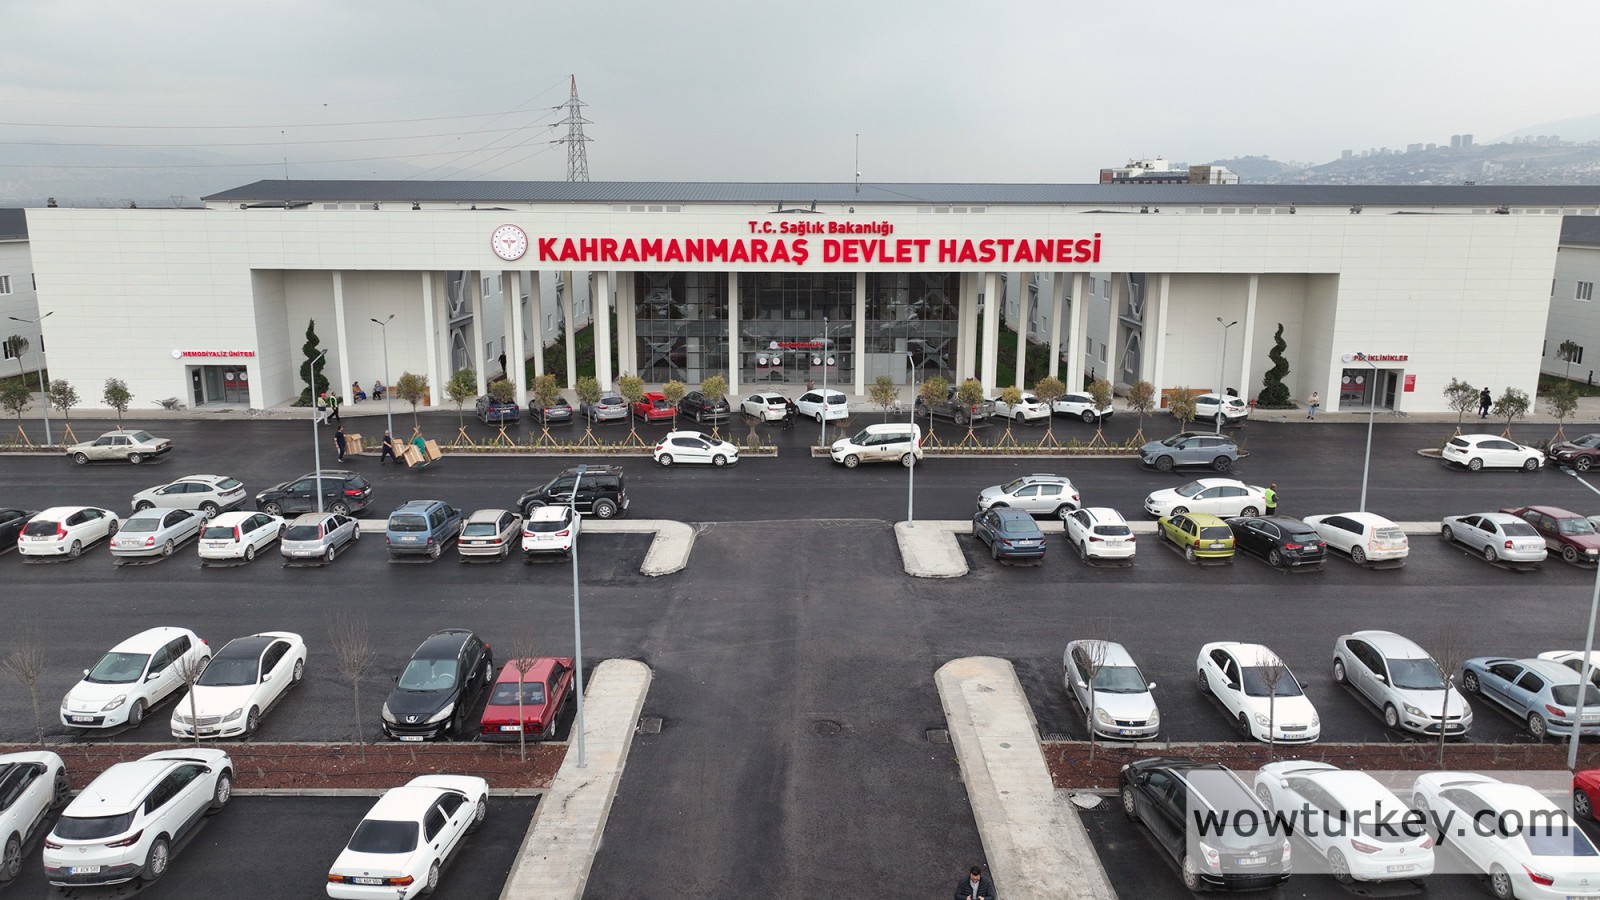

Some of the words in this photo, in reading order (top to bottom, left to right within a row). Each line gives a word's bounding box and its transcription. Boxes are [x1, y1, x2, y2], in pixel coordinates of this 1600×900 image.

[748, 220, 777, 234] T.C.
[779, 220, 825, 237] Sağlık
[828, 220, 895, 237] Bakanlığı
[537, 237, 810, 266] KAHRAMANMARAŞ
[822, 238, 932, 263] DEVLET
[937, 232, 1102, 263] HASTANESİ
